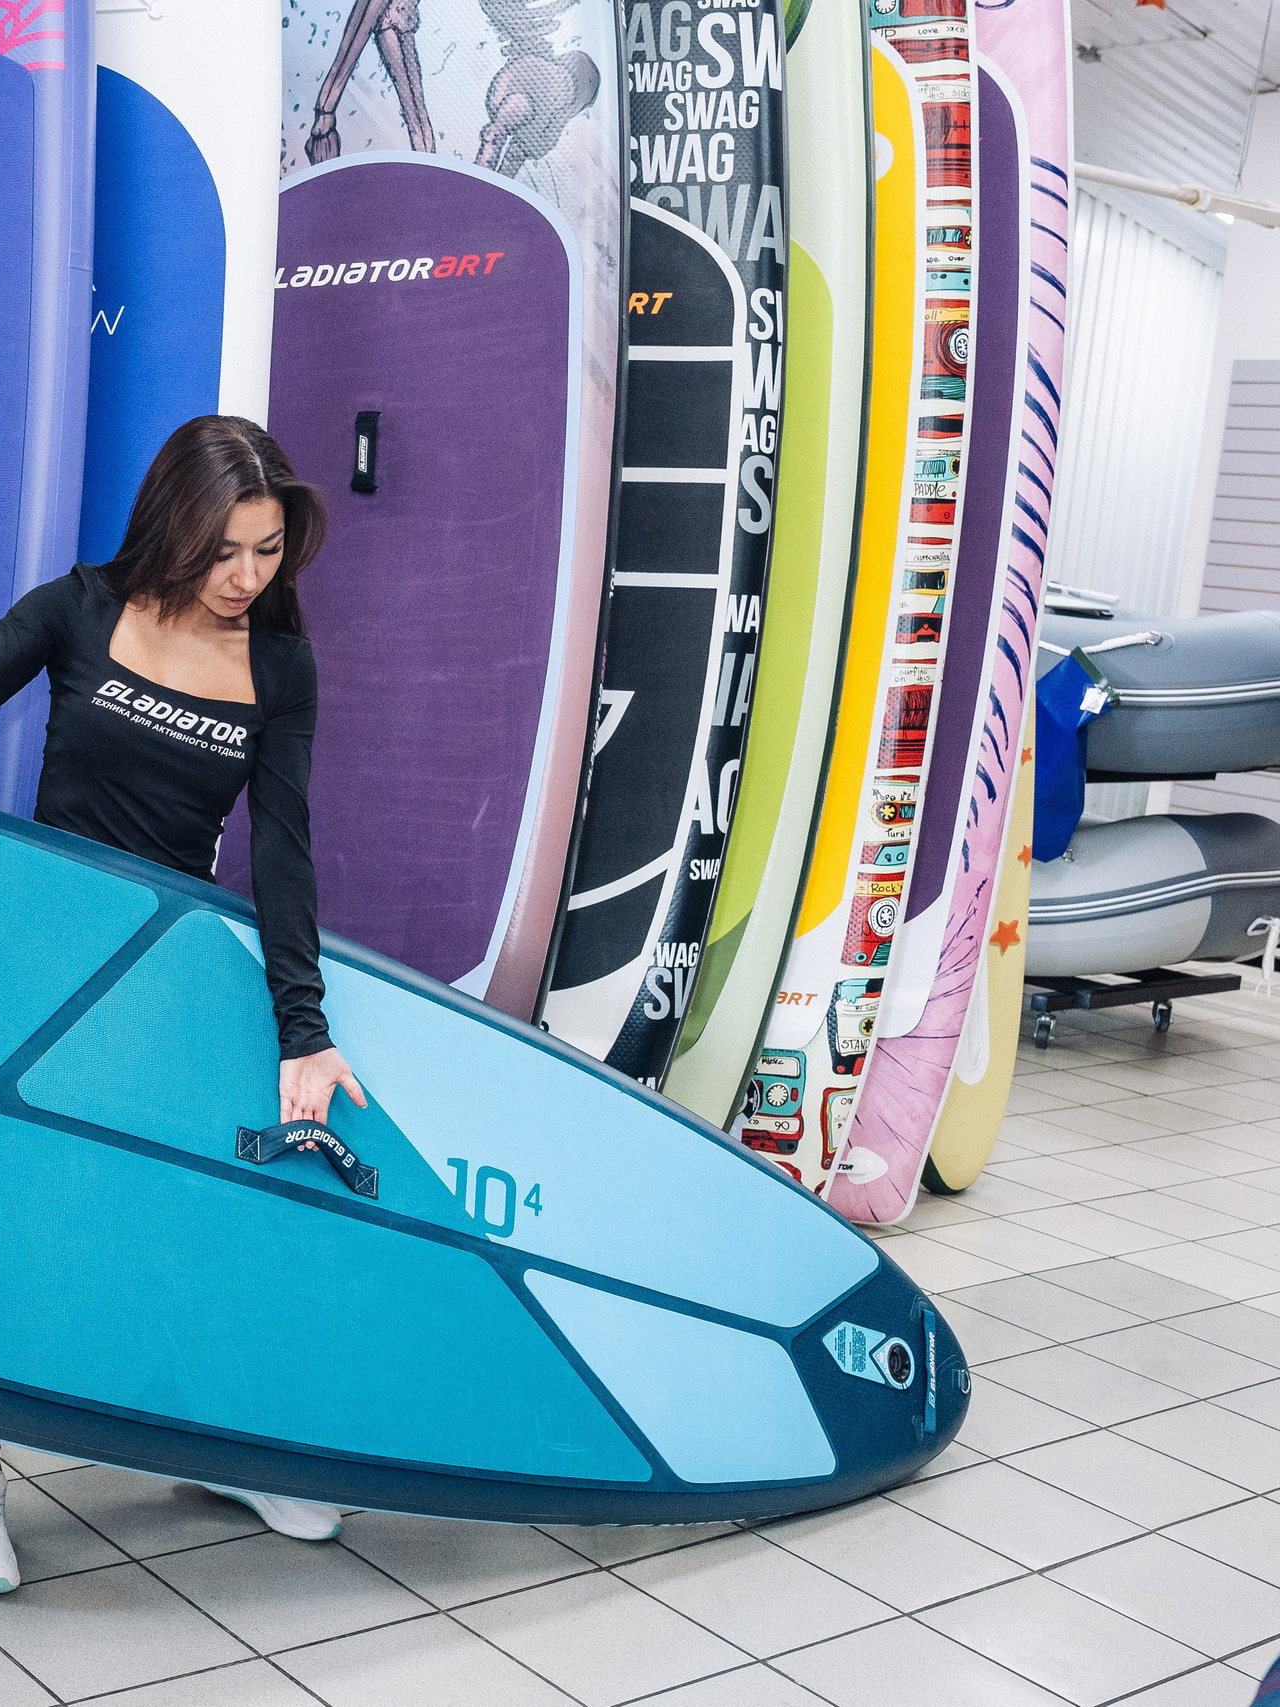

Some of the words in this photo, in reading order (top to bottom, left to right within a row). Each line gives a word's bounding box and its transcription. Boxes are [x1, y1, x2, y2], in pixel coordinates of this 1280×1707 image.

[627, 2, 692, 61] AG
[695, 12, 783, 91] SW
[664, 90, 759, 131] SWAG
[630, 132, 735, 183] WAG
[749, 288, 783, 342] S
[738, 455, 774, 534] S
[91, 696, 131, 718] ТЕХНИКА
[130, 713, 152, 728] ДЛЯ
[153, 723, 208, 749] АКТИВНОГО
[210, 743, 246, 760] ОТДЫХА
[649, 942, 700, 968] WAG
[775, 1121, 790, 1130] 90
[838, 1163, 854, 1171] TOR
